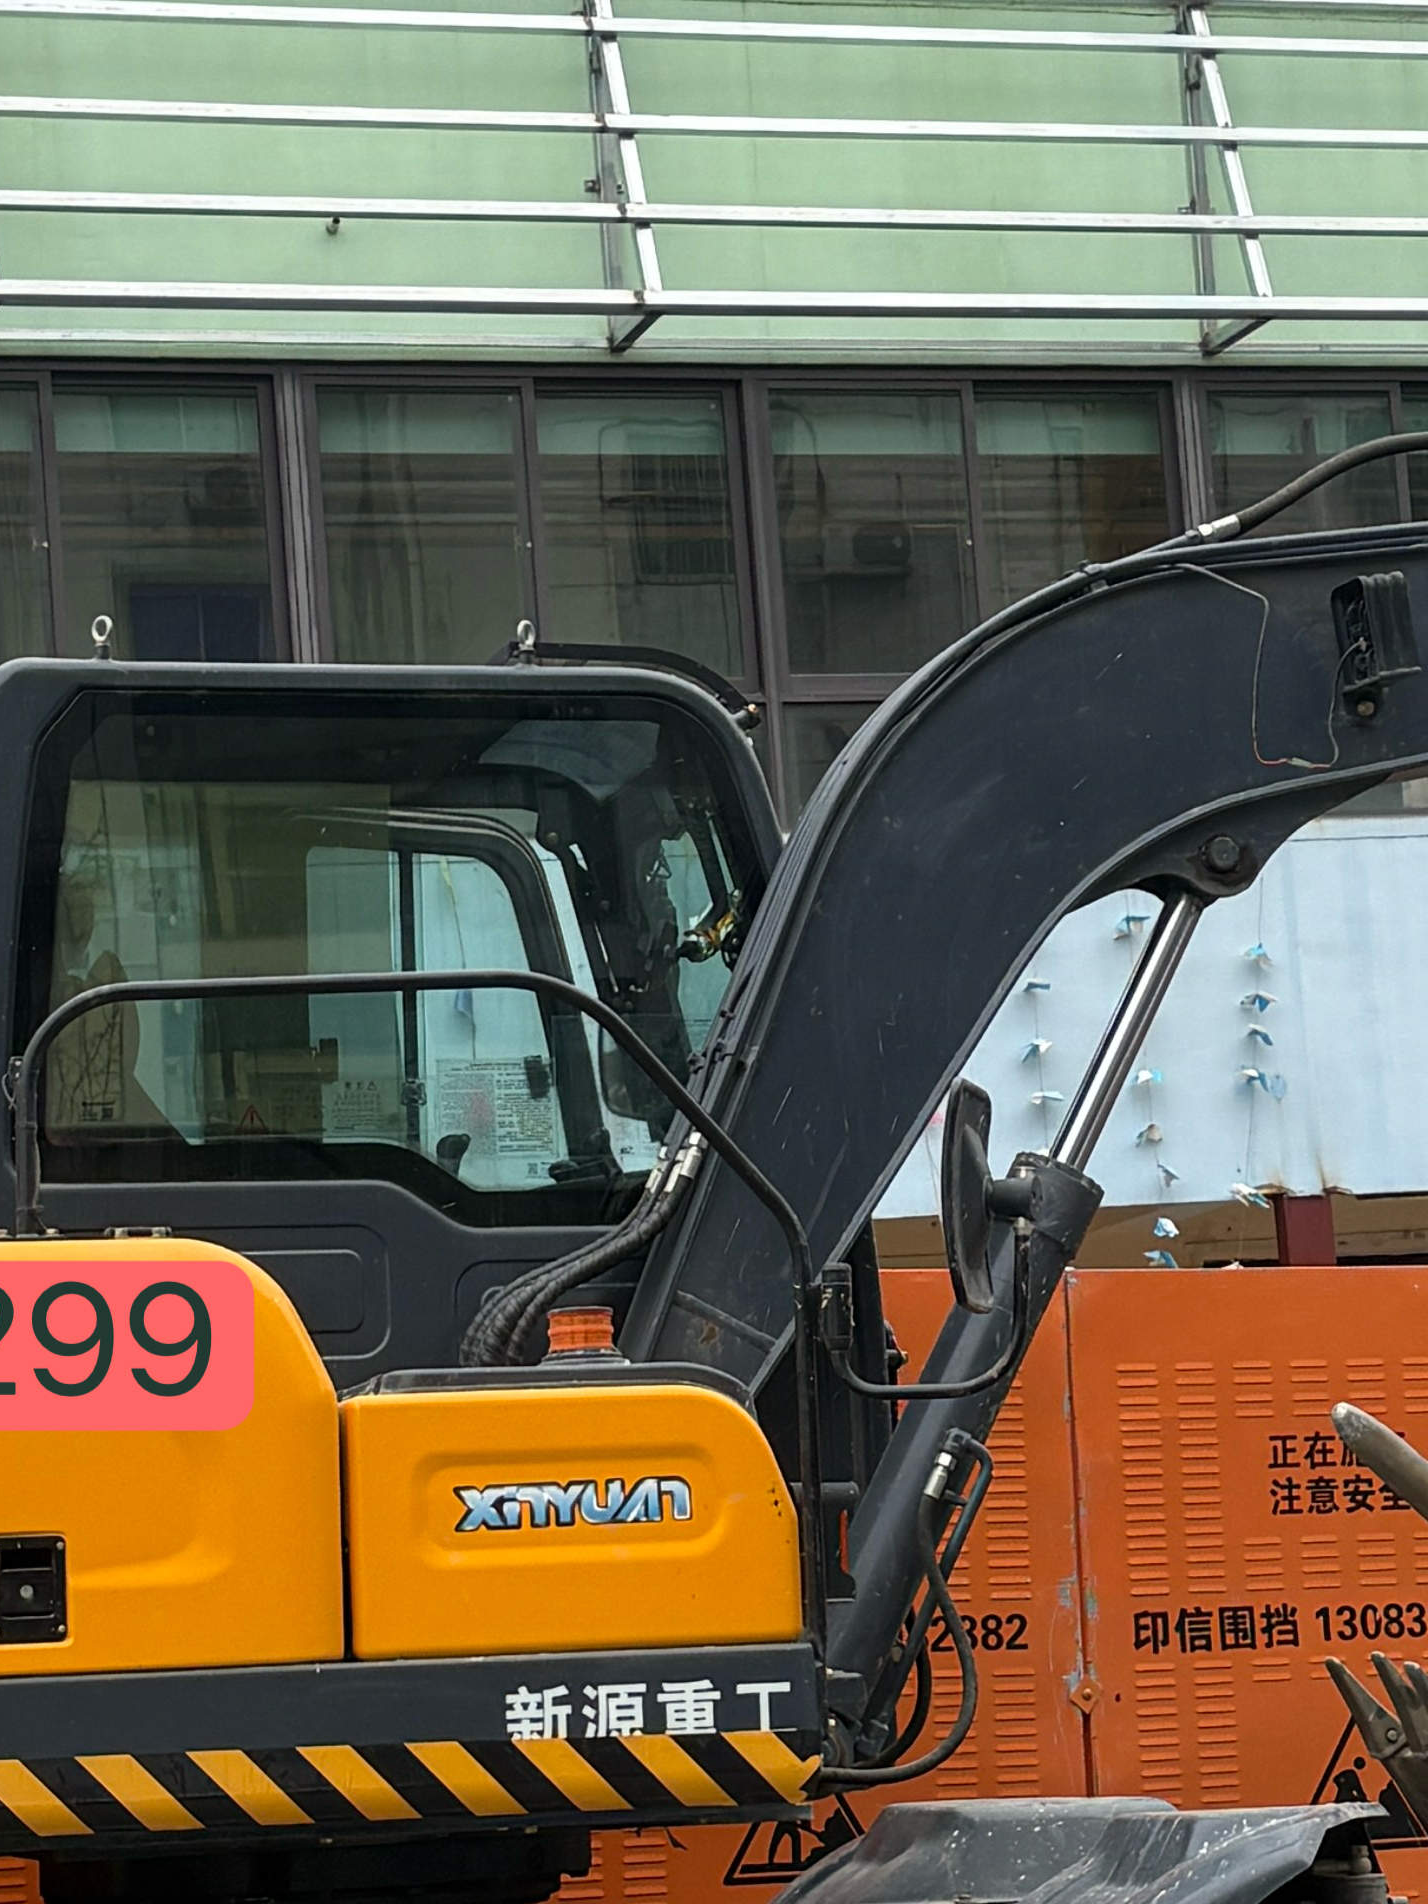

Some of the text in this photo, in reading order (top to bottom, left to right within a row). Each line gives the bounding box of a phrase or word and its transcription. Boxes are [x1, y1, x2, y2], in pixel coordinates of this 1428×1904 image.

[1133, 1603, 1300, 1654] 印信围挡
[505, 1679, 798, 1739] 新源重工
